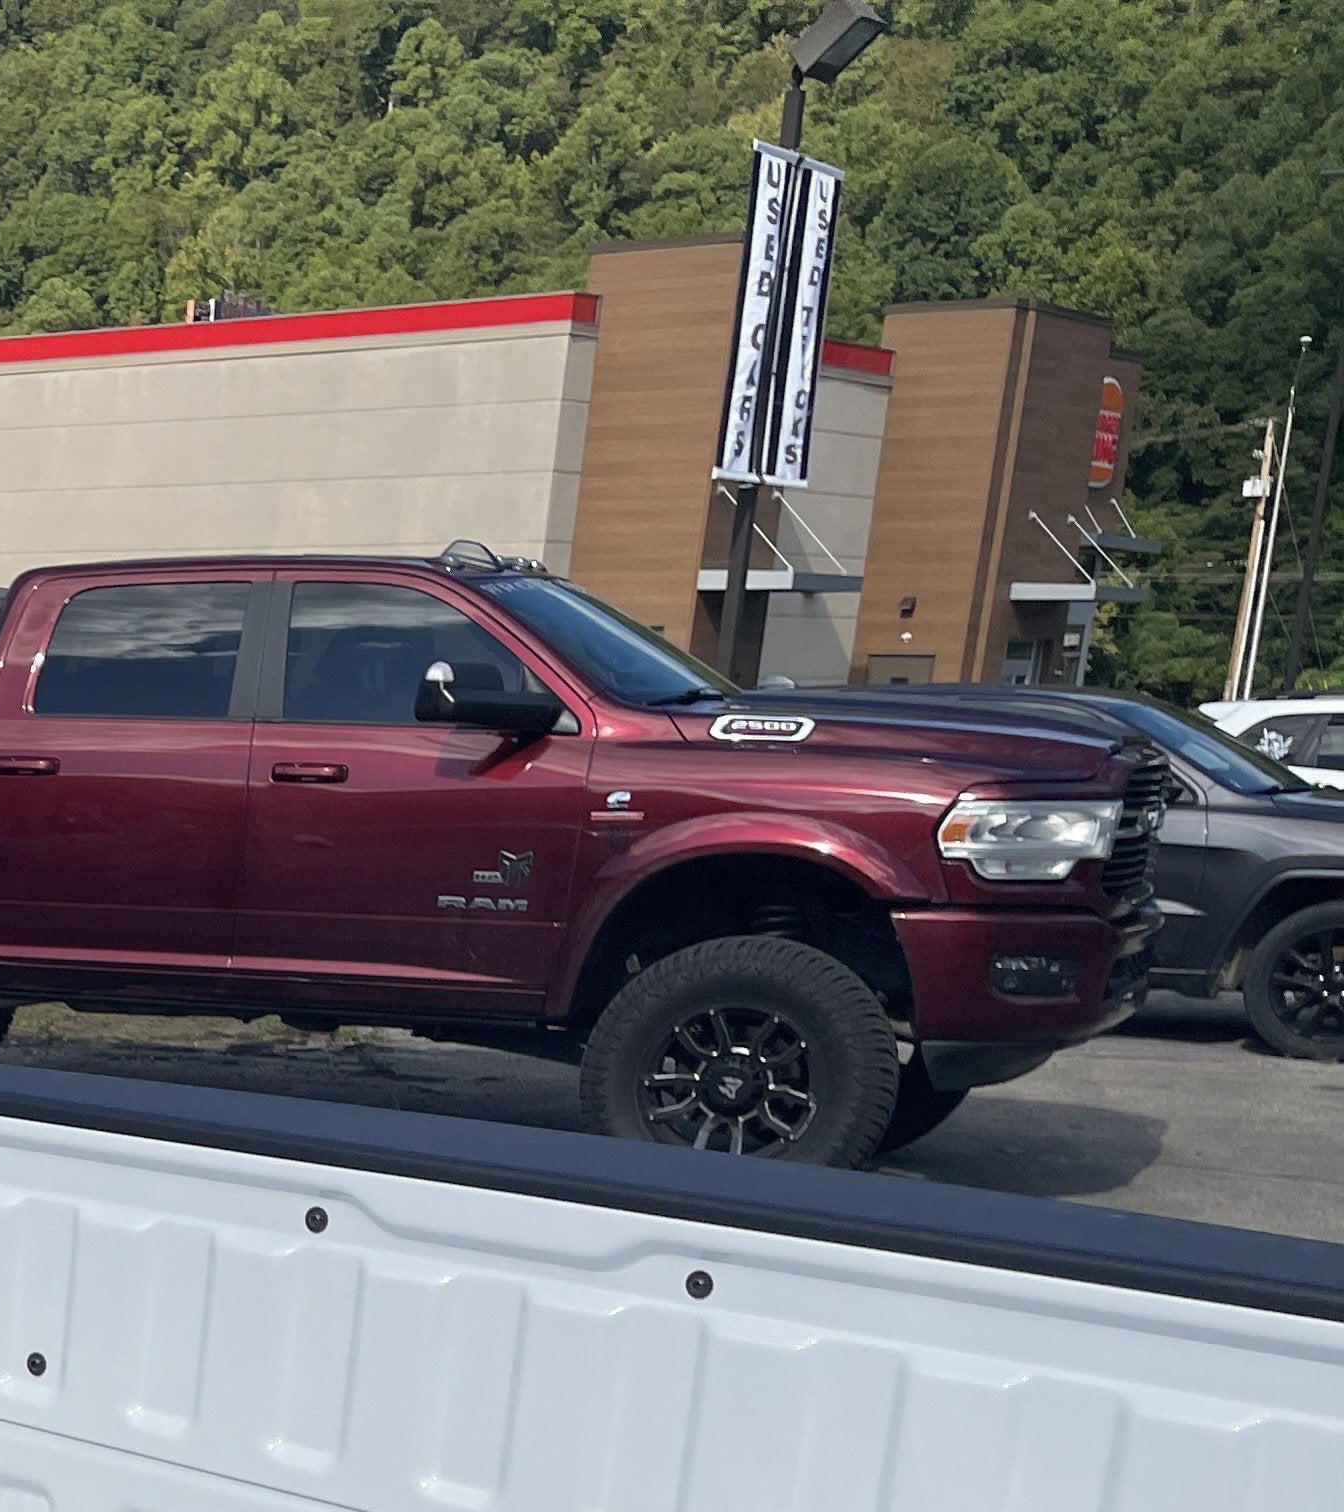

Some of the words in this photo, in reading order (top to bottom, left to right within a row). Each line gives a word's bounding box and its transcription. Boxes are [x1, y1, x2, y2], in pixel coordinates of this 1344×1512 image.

[756, 160, 781, 297] USED
[807, 180, 830, 287] USED
[436, 895, 529, 912] RAM
